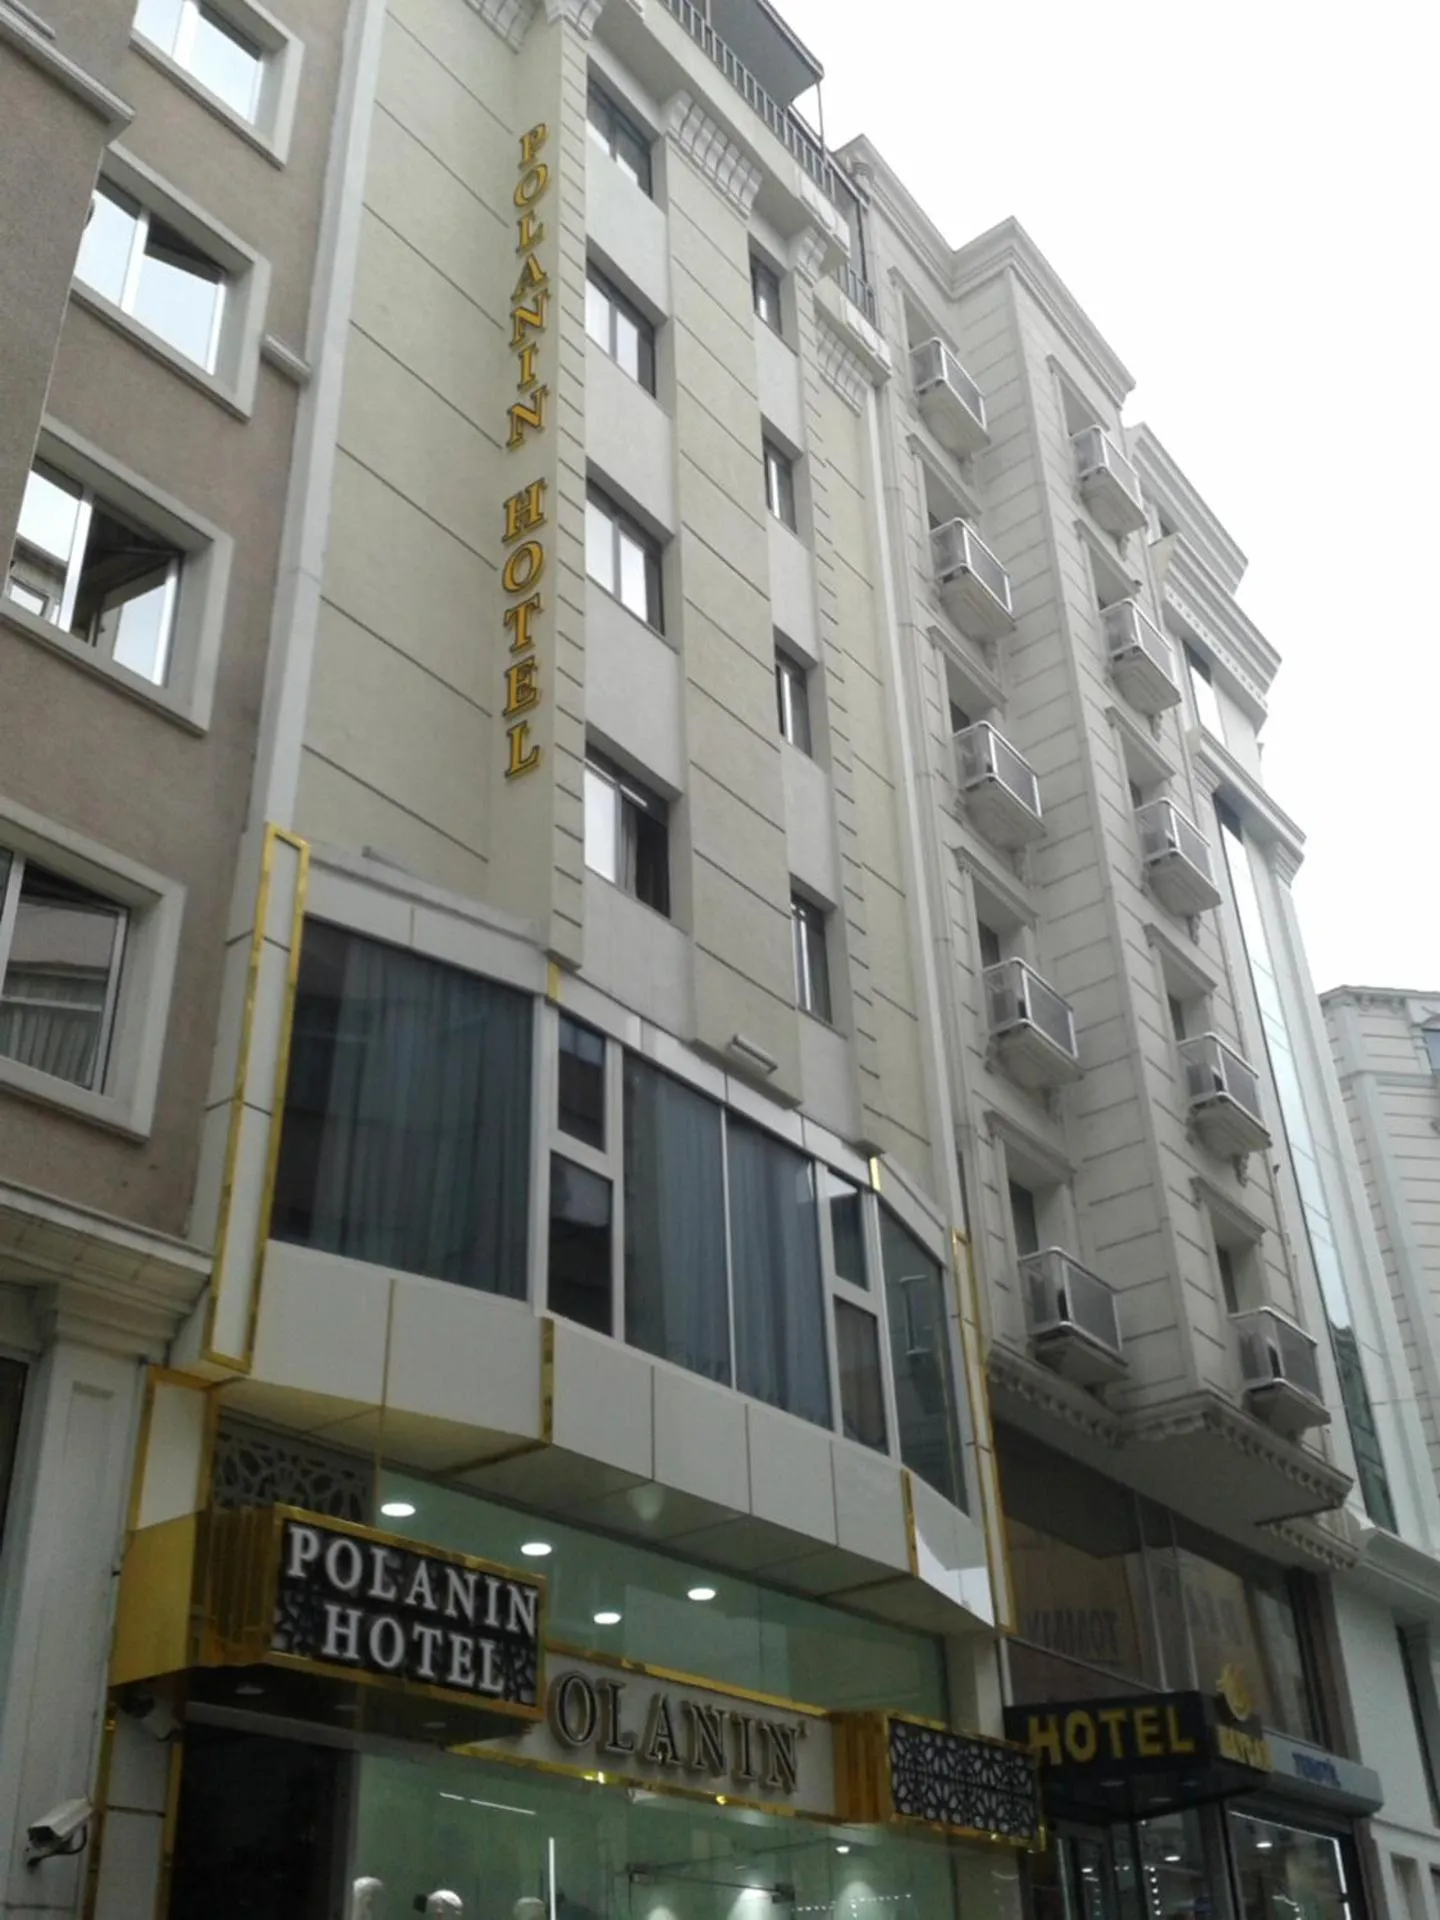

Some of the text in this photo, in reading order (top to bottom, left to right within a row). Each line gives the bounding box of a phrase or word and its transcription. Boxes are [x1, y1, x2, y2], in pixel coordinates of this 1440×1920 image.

[502, 122, 551, 779] POLANIN HOTEL
[287, 1523, 539, 1638] POLANIN
[321, 1603, 503, 1692] HOTEL
[547, 1669, 799, 1794] OLANIN
[1027, 1704, 1195, 1766] HOTEL
